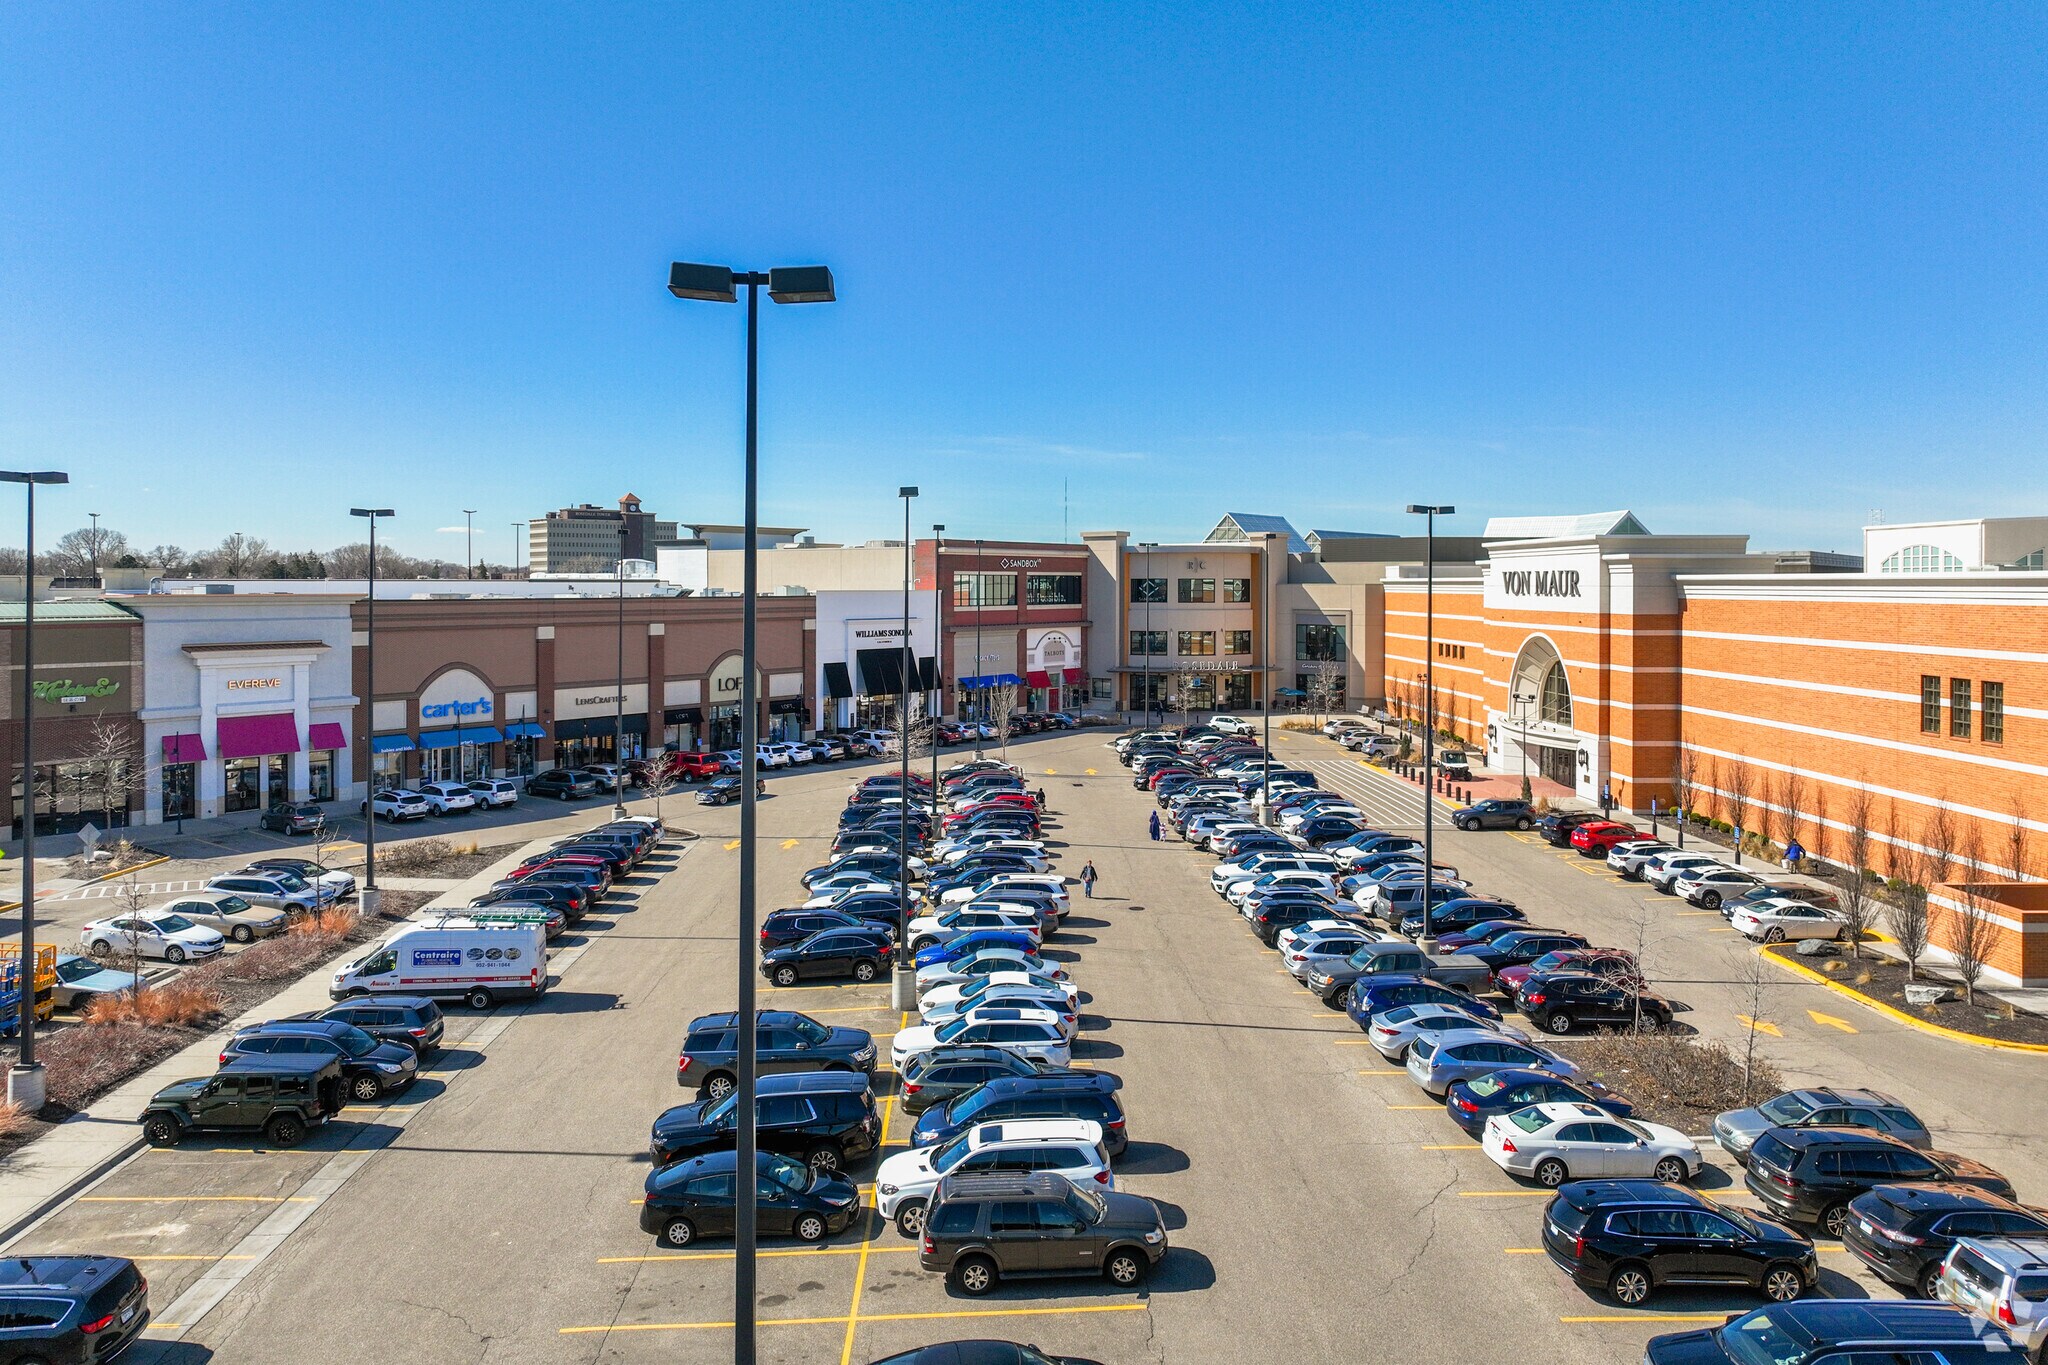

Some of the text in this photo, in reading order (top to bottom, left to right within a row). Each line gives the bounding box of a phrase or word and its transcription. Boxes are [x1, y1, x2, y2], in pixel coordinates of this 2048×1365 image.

[1010, 559, 1037, 568] SANDBOX
[1502, 570, 1581, 597] VON MAUR
[855, 629, 913, 638] WILLIAMS SONOA
[1172, 660, 1239, 671] ROSEDALE
[227, 678, 281, 690] EVEREVE
[718, 677, 743, 692] LOF
[414, 950, 460, 959] Centraire
